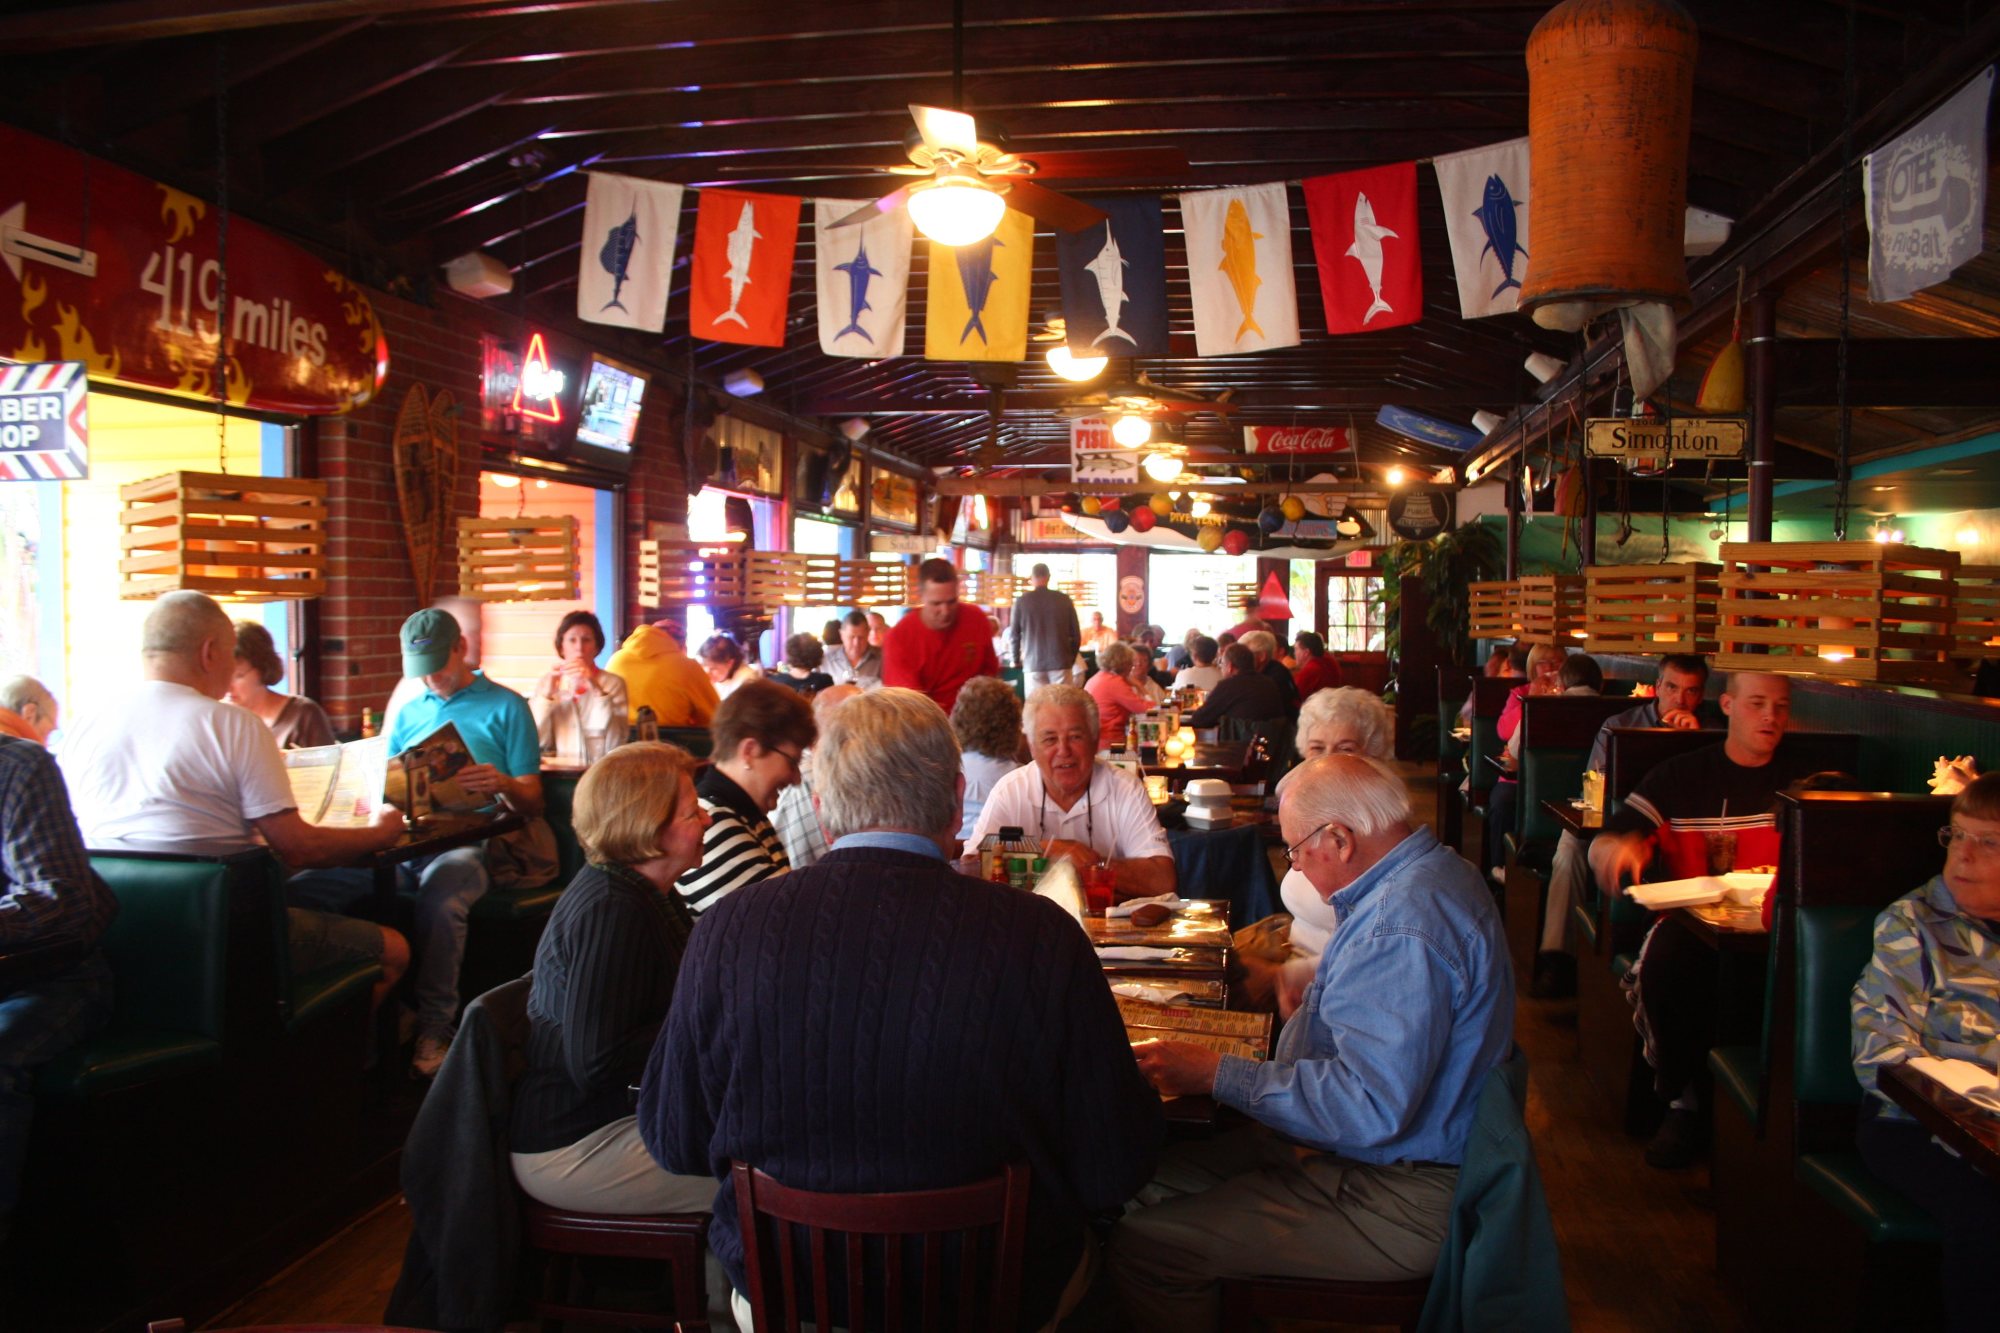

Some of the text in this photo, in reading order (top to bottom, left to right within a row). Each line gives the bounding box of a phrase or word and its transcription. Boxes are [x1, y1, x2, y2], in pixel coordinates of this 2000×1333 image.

[140, 245, 328, 367] 419 miles
[0, 396, 62, 422] BER
[0, 424, 41, 449] OP
[1267, 427, 1335, 452] Coca-Cola
[1612, 427, 1718, 451] Simonton
